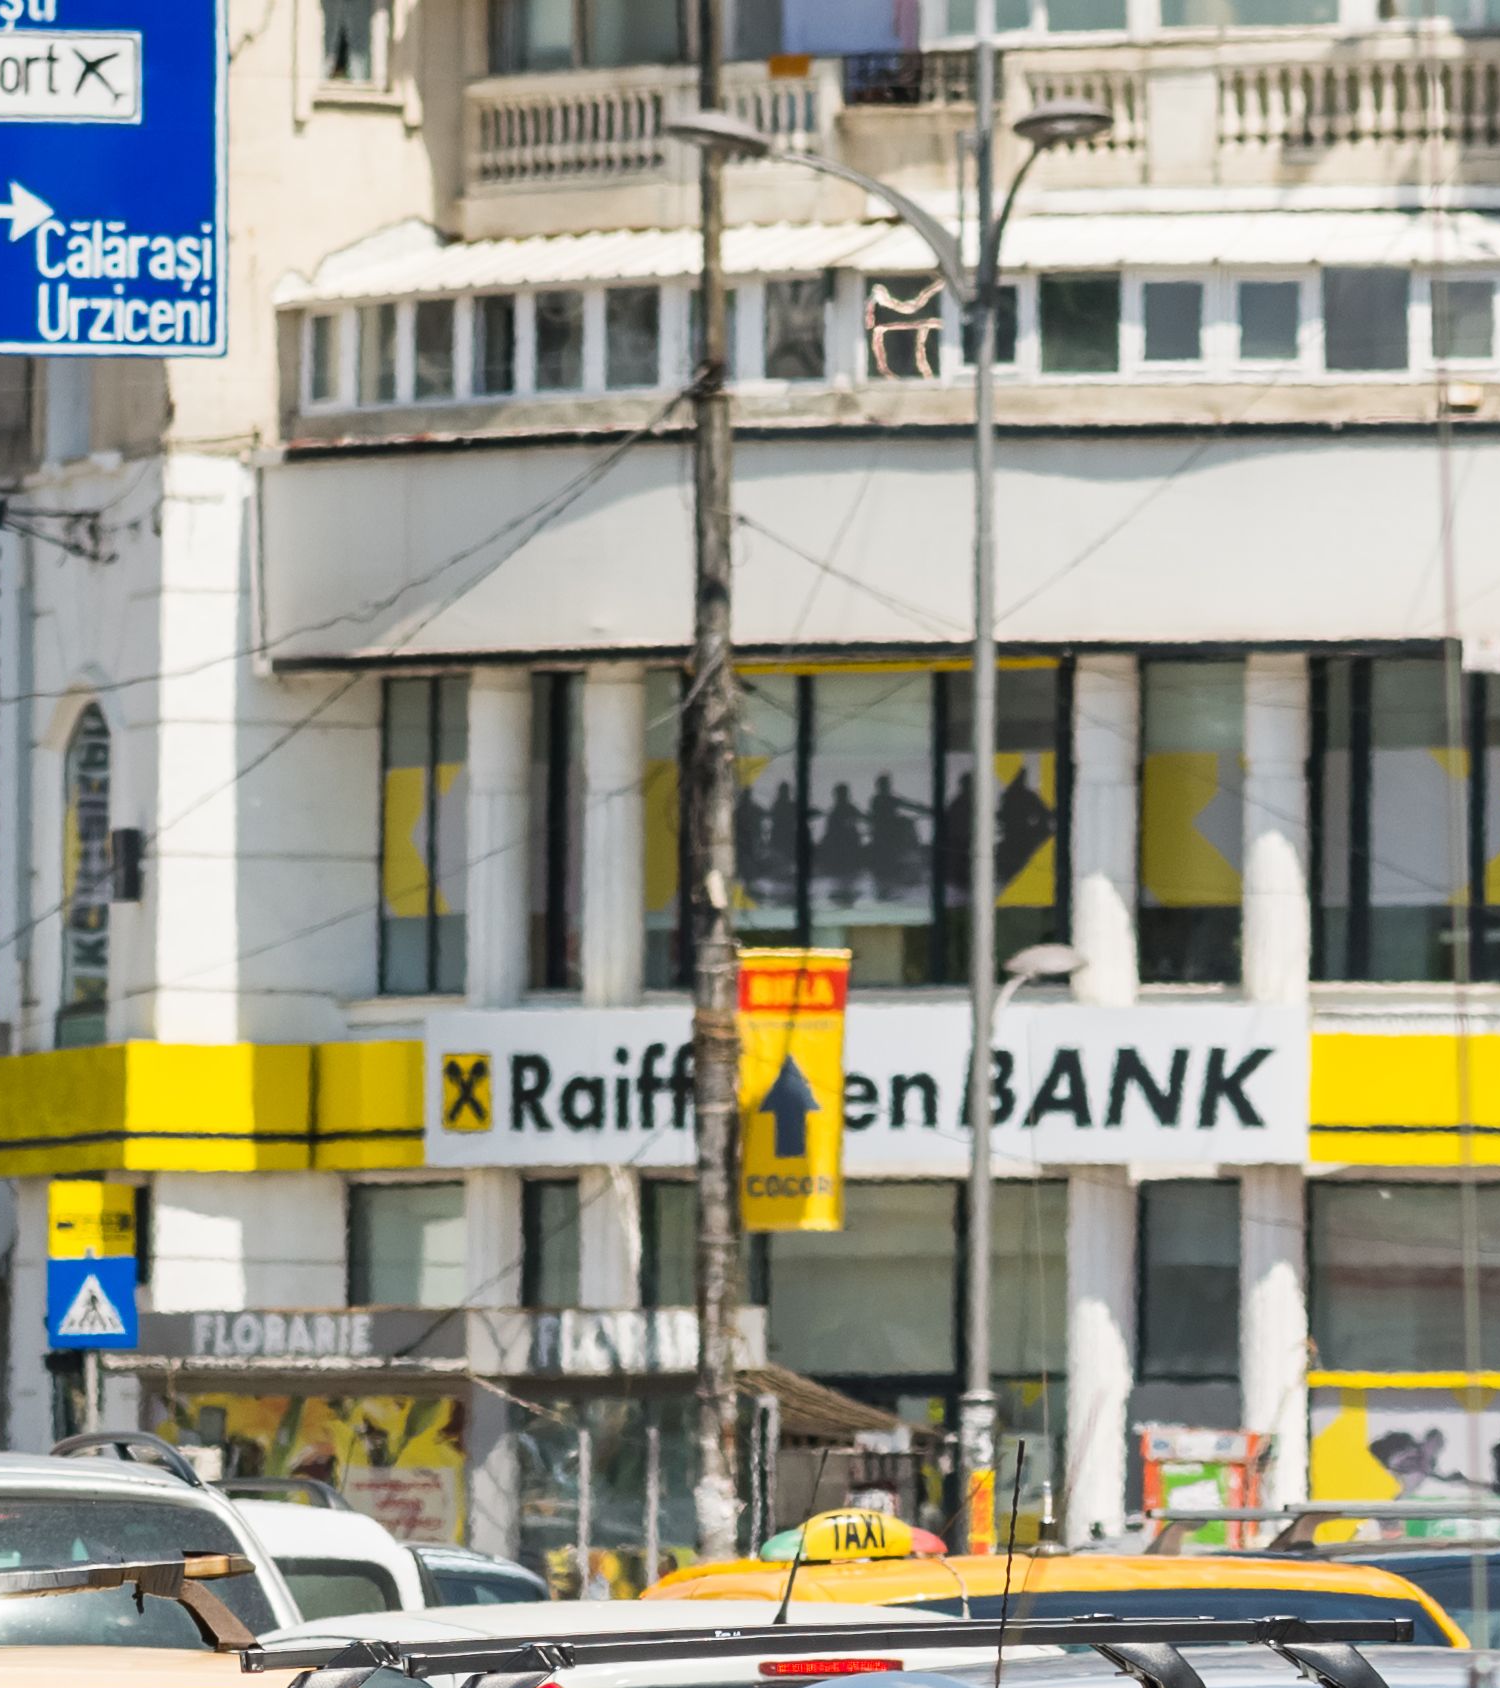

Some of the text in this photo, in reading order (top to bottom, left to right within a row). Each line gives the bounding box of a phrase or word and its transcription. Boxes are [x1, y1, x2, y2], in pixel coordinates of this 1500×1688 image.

[36, 220, 213, 292] Călărași
[36, 283, 211, 343] Urziceni
[510, 1040, 1275, 1135] Raiffen BANK
[746, 1174, 834, 1199] COCOR
[192, 1312, 374, 1358] FLORARIE
[830, 1513, 887, 1553] TAXI
